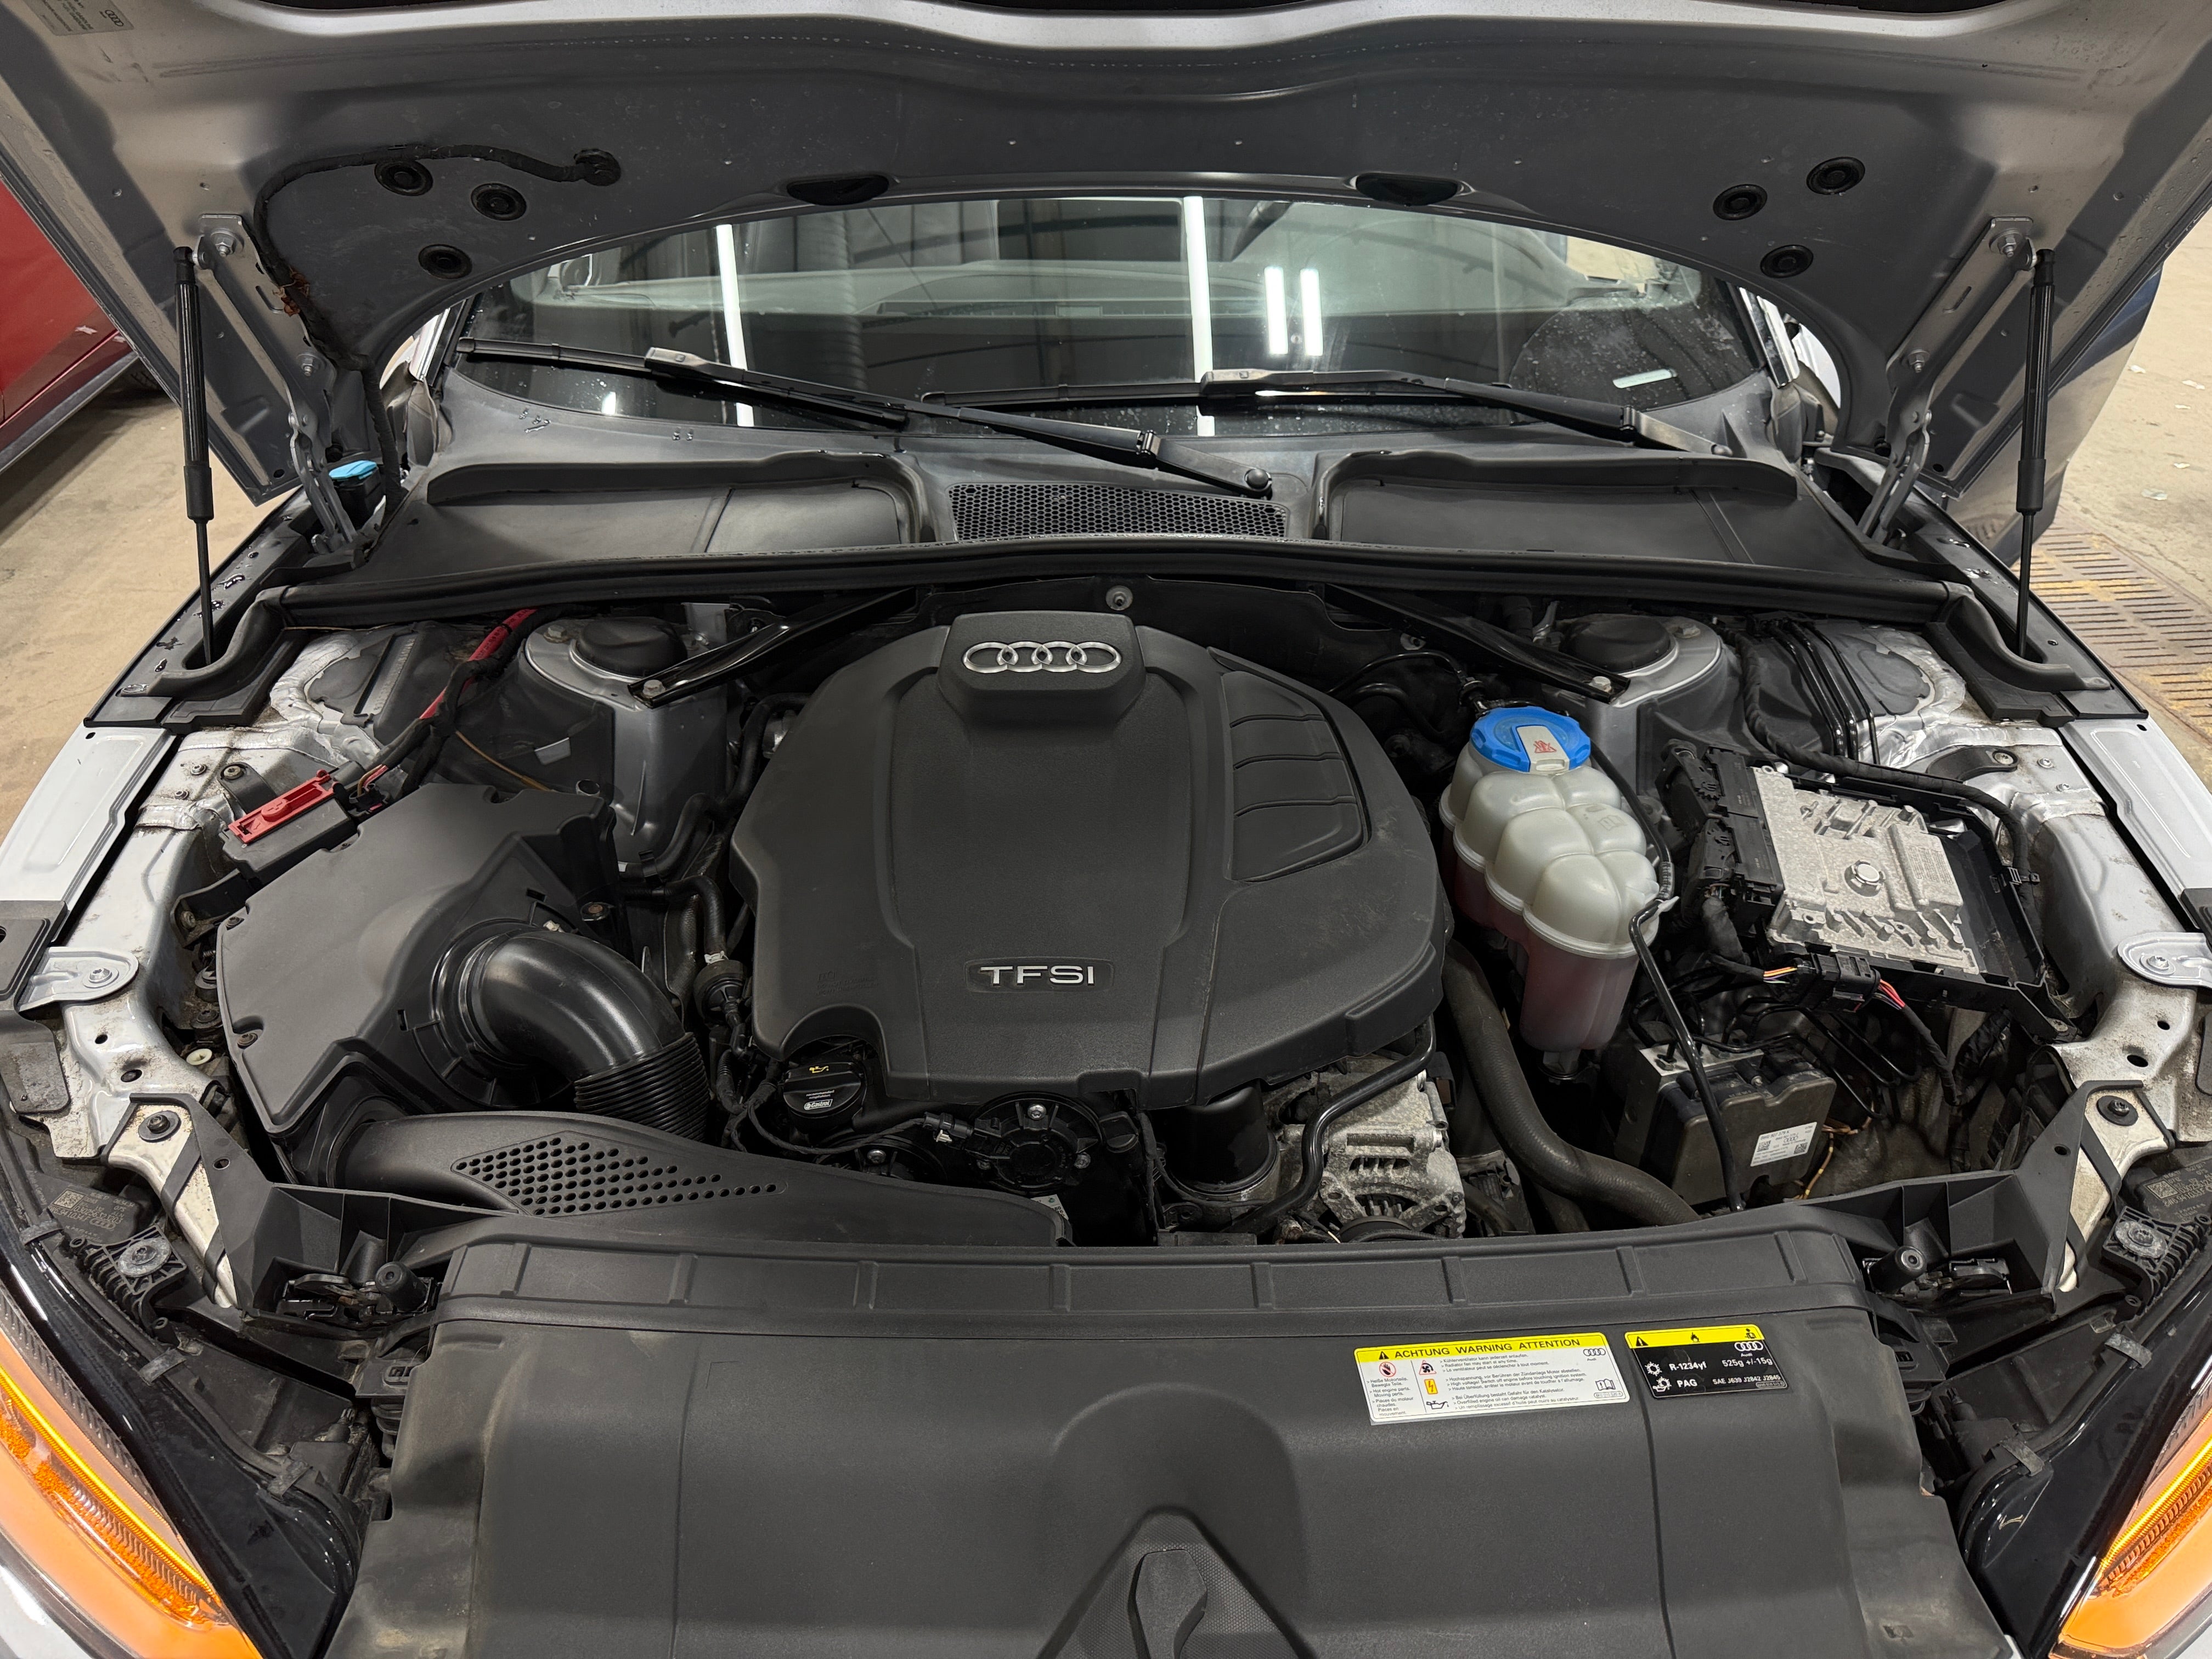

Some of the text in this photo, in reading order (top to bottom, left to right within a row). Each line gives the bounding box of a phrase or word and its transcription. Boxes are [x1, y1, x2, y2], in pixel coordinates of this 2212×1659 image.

[980, 966, 1094, 986] TFSI
[1395, 1339, 1580, 1358] ACHTUNG WARNING ATTENTION
[1669, 1361, 1707, 1371] R-1234yf
[1746, 1357, 1773, 1365] +/-15g
[1677, 1379, 1698, 1388] PAG
